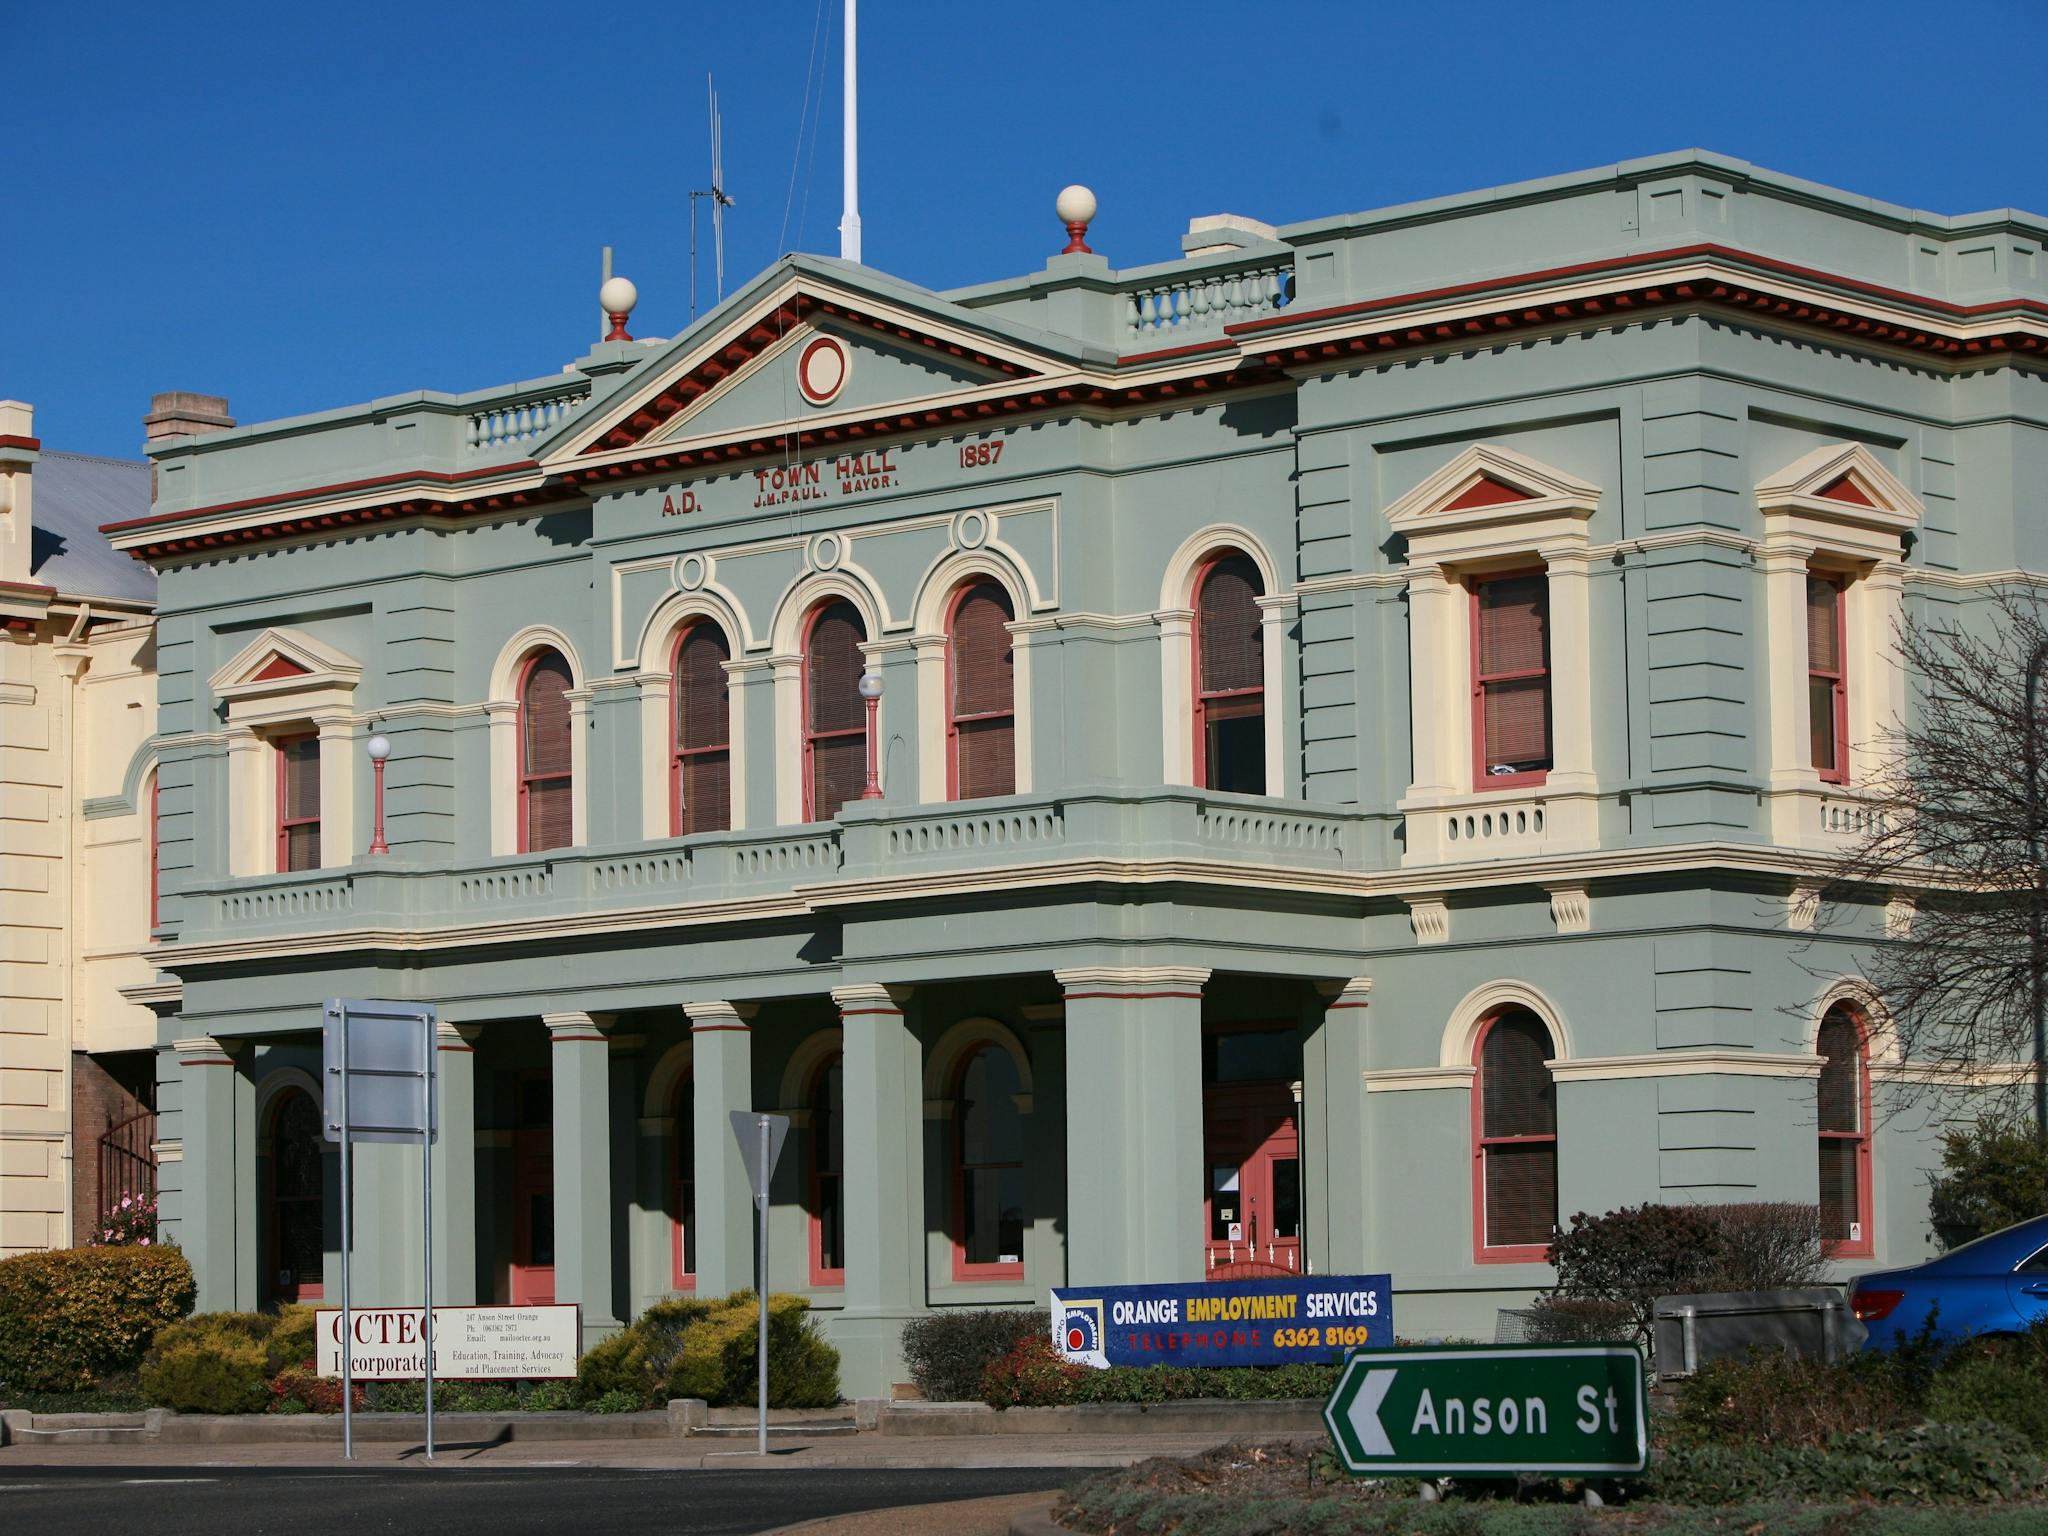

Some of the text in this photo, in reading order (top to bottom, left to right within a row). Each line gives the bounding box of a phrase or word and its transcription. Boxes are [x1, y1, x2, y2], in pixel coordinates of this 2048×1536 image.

[960, 440, 1005, 468] 1887
[754, 453, 897, 492] TOWN HALL
[662, 491, 702, 517] A.D.
[478, 1313, 495, 1321] Anson
[498, 1312, 515, 1320] Street
[518, 1312, 539, 1321] Orange
[1112, 1291, 1378, 1325] ORANGE EMPLOYMENT SERVICES
[332, 1313, 438, 1344] OCTEC
[1128, 1330, 1260, 1350] TELEPHONE
[1273, 1326, 1368, 1347] 6362 8169
[334, 1350, 438, 1376] Icorporated
[452, 1350, 564, 1361] Education, Training, Advocacy
[465, 1363, 552, 1374] and Placement Services
[1411, 1384, 1619, 1435] Anson St
